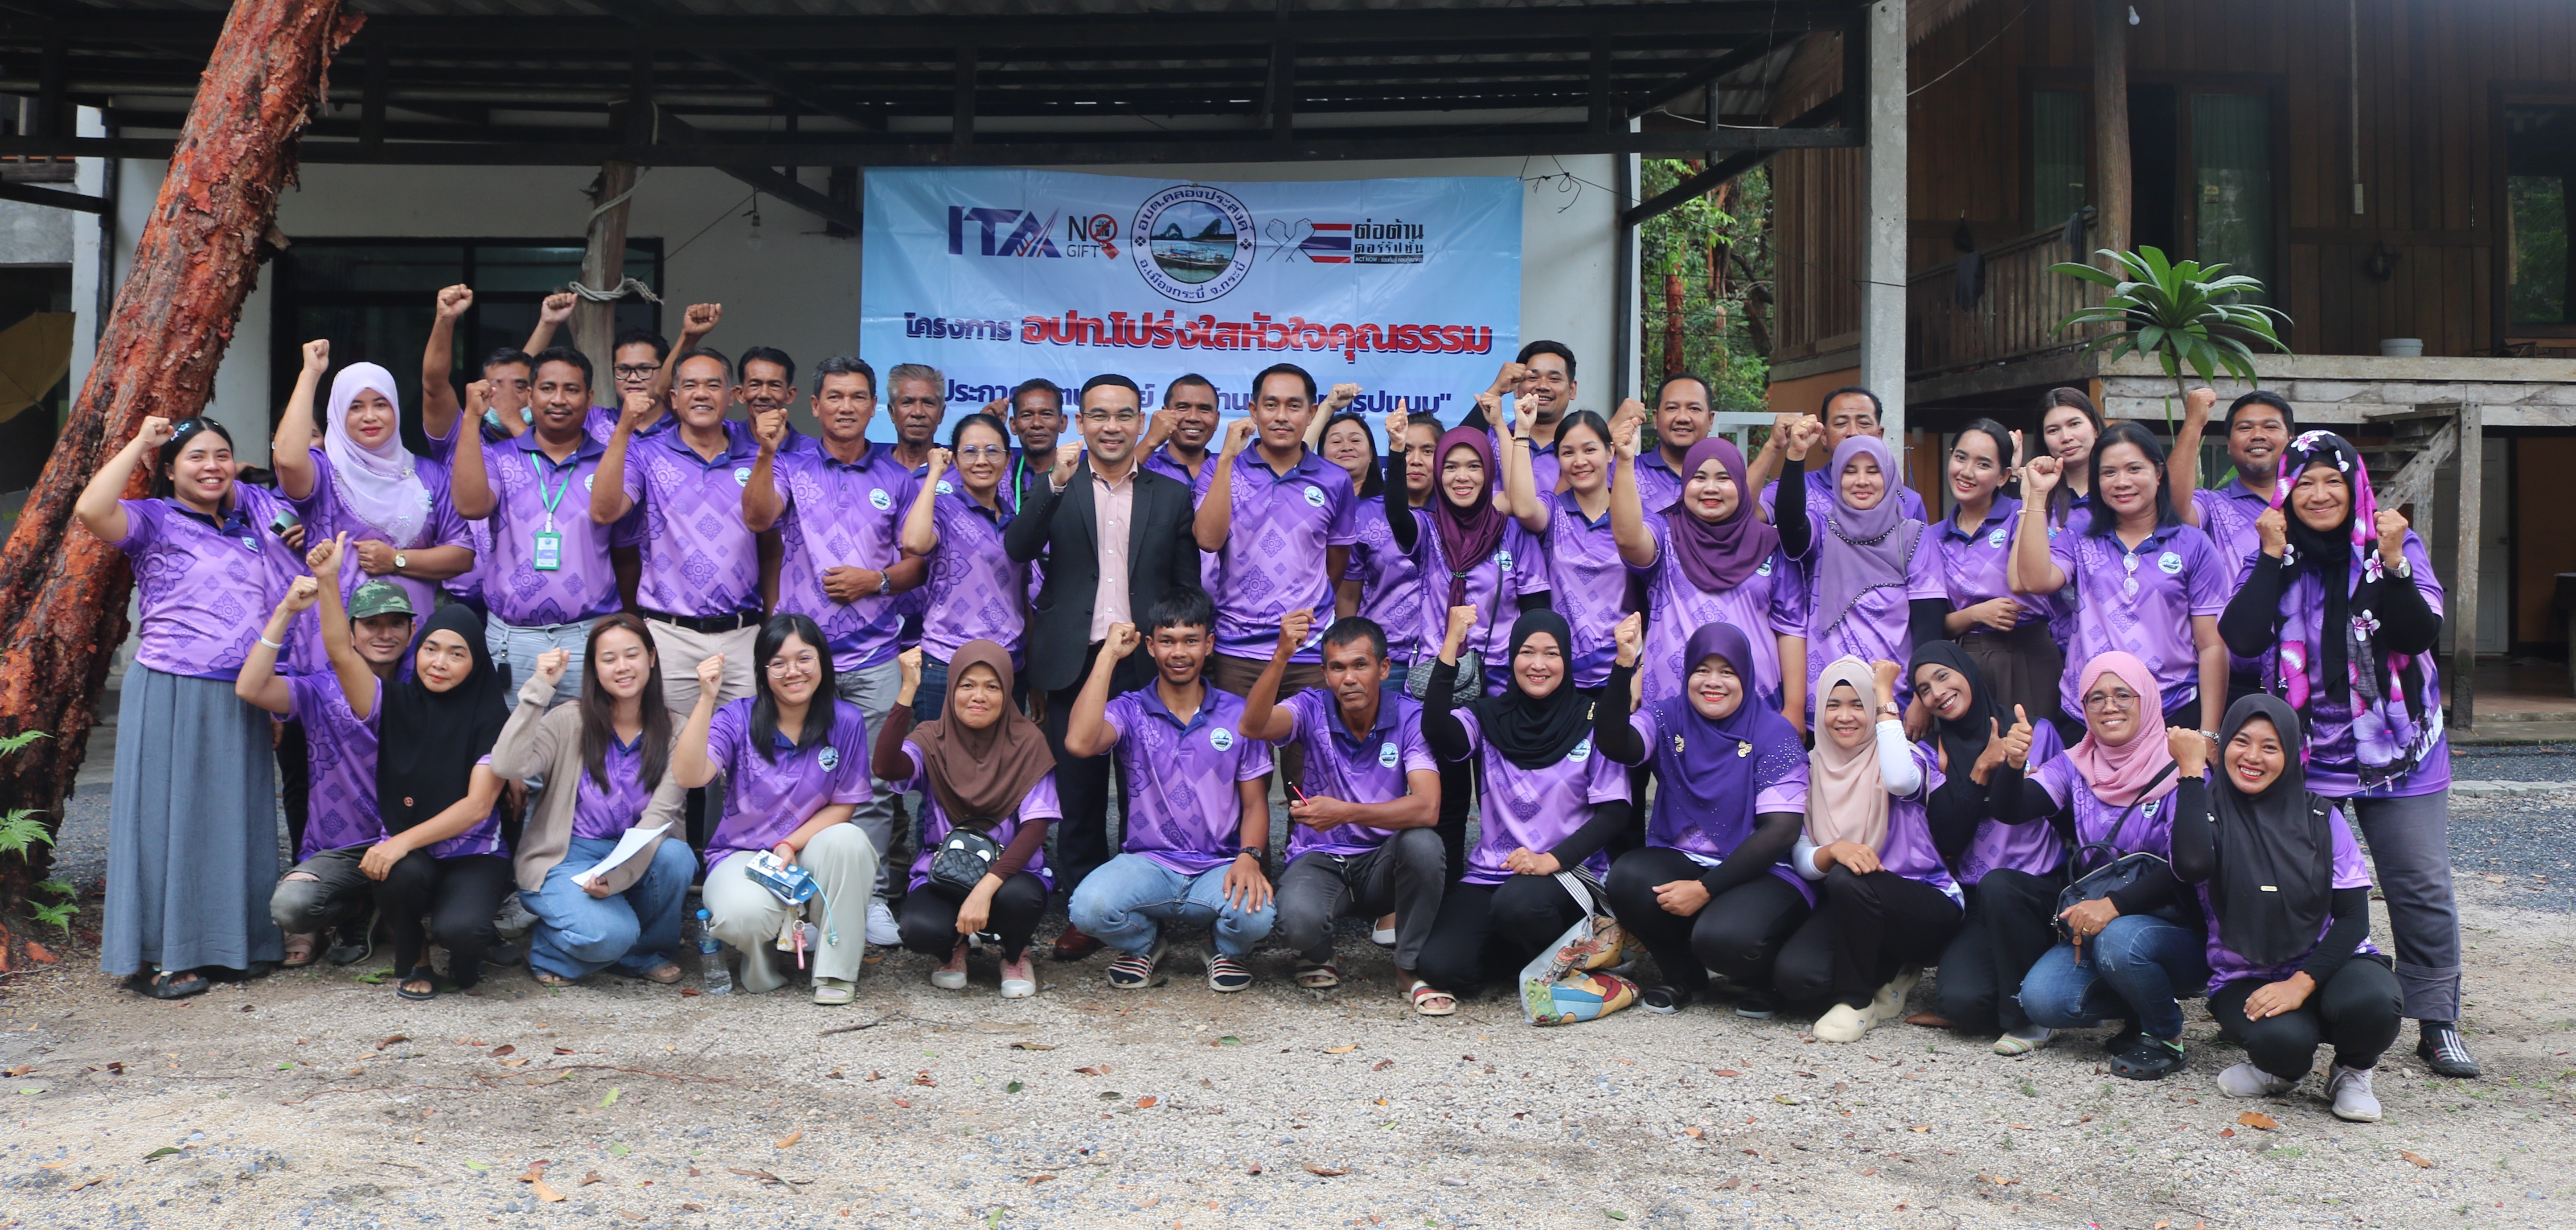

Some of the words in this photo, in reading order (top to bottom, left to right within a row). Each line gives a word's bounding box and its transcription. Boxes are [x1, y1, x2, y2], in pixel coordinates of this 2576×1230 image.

[1138, 190, 1253, 231] อบต.คลองประสงค์
[1354, 218, 1424, 239] ต่อต้าน
[948, 206, 1062, 258] ITA
[1066, 244, 1101, 258] GIFT
[1140, 259, 1205, 299] อ.เมืองกระบี่
[1210, 259, 1246, 295] จ.กระบี่
[904, 313, 1012, 341] โครงการ
[1021, 309, 1493, 365] อปท.โปร่งใสหัวใจคุณธรรม
